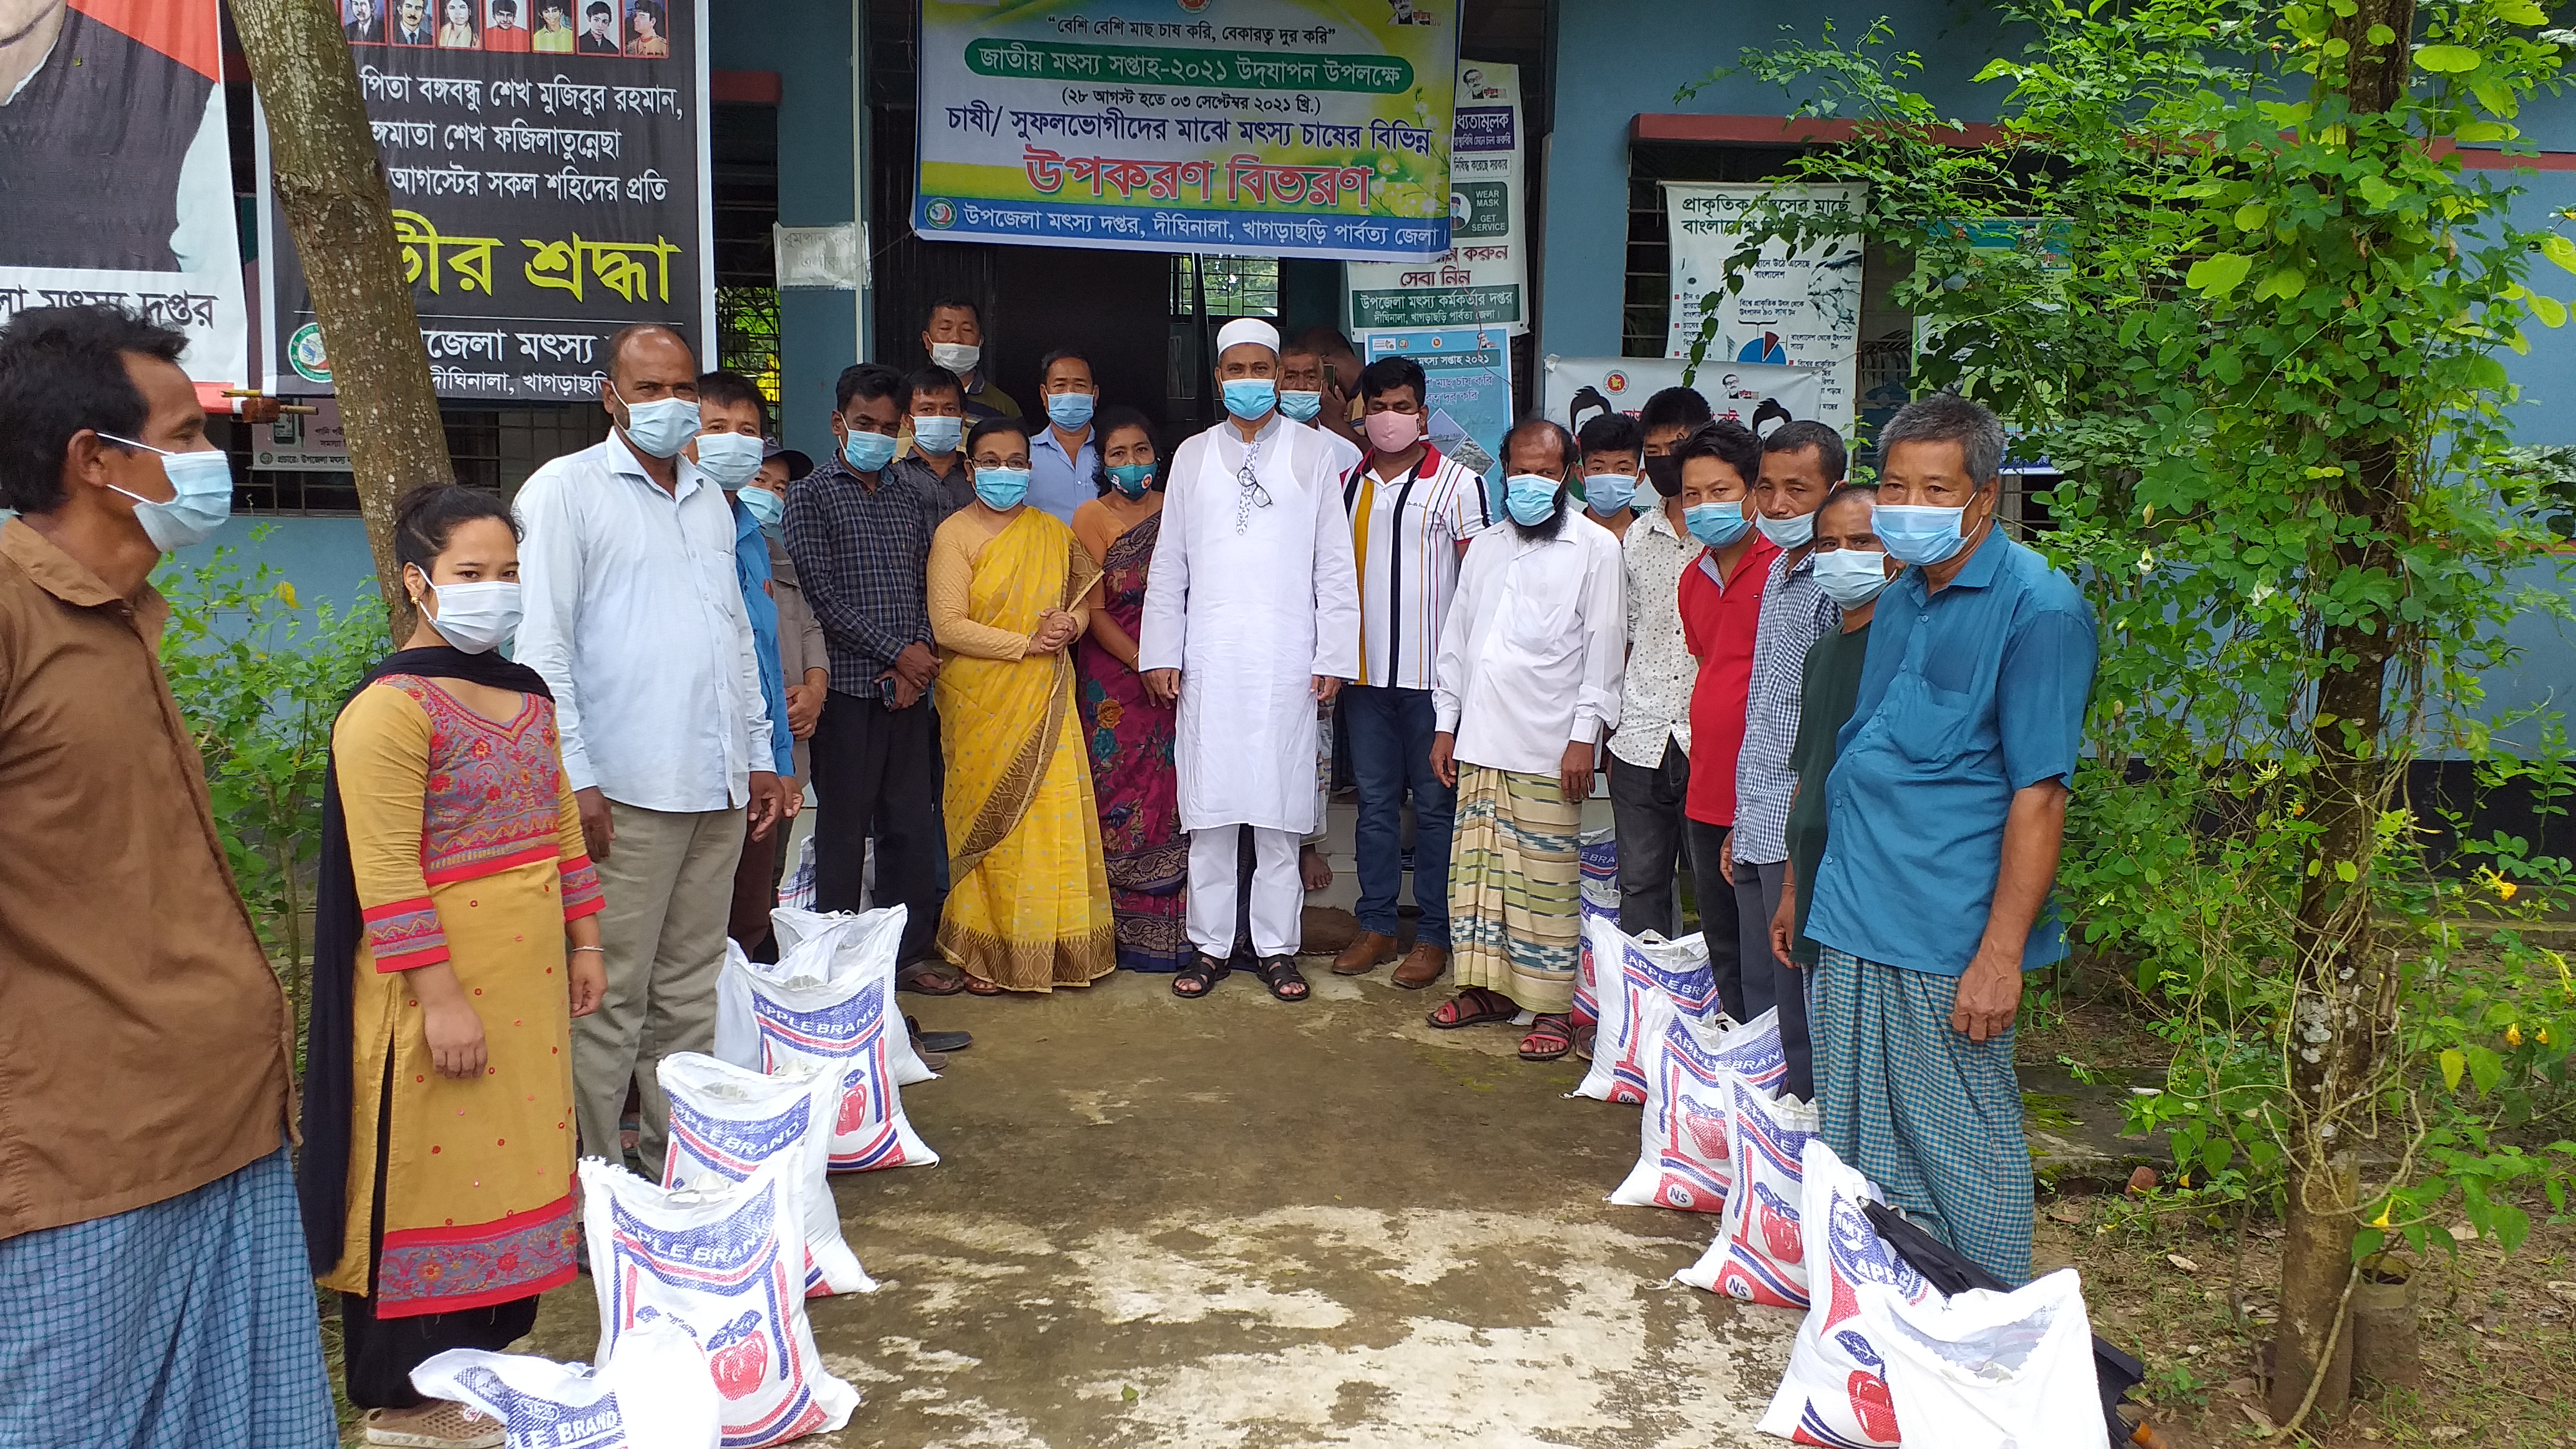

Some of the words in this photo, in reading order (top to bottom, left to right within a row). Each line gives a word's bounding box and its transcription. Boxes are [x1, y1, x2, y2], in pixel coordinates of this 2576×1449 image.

[1093, 16, 1125, 36] বেশি
[1129, 21, 1154, 38] মাছ
[1158, 22, 1181, 39] চাষ
[1186, 21, 1216, 42] করি,
[1222, 25, 1274, 46] বেকারত্ব
[978, 42, 1045, 72] জাতীয়
[1050, 52, 1103, 76] মৎস্য
[1322, 57, 1402, 87] উপলক্ষে
[359, 65, 412, 104] পিতা
[416, 76, 483, 114] বঙ্গবন্ধু
[490, 78, 532, 109] শেখ
[537, 74, 607, 118] মুজিবুর
[613, 85, 683, 121] রহমান,
[1092, 87, 1136, 105] আগস্ট
[1138, 92, 1166, 108] হতে
[1171, 96, 1191, 107] ০৩
[1196, 91, 1248, 110] সেপ্টেম্বর
[1254, 98, 1290, 113] ২০২১
[1009, 106, 1169, 142] সুফলভোগীদের
[1175, 116, 1231, 144] মাঝে
[1237, 121, 1296, 148] মৎস্য
[1300, 120, 1364, 150] চাষের
[1368, 118, 1433, 157] বিভিন্ন
[1455, 114, 1509, 133] ধ্যতামূলক
[368, 119, 437, 150] ঙ্গমাতা
[444, 121, 486, 153] শেখ
[492, 117, 623, 162] ফজিলাতুন্নেছা
[1023, 143, 1216, 202] উপকরণ
[1224, 152, 1373, 208] বিতরণ
[1490, 159, 1508, 170] সরকার
[388, 161, 481, 197] আগস্টের
[488, 172, 539, 200] সকল
[545, 165, 620, 205] শহিদের
[627, 168, 670, 204] প্রতি
[1475, 190, 1500, 198] WEAR
[1476, 199, 1500, 207] MASK
[963, 203, 1043, 230] উপজেলা
[1047, 213, 1095, 233] মৎস্য
[1099, 215, 1146, 238] দপ্তর,
[1151, 212, 1235, 242] দীঘিনালা,
[1242, 218, 1328, 246] খাগড়াছড়ি
[1334, 220, 1390, 245] পার্বত্য
[1471, 223, 1506, 232] SERVICE
[1461, 245, 1509, 262] করুন
[520, 230, 683, 305] শ্রদ্ধা
[1399, 271, 1437, 288] সেবা
[1440, 265, 1471, 286] নিন
[1359, 293, 1406, 310] উপজেলা
[1408, 295, 1436, 309] মৎস্য
[1438, 288, 1486, 308] কর্মকর্তার
[1488, 291, 1514, 305] দপ্তর
[1373, 311, 1408, 325] দীঘিনালা,
[1410, 310, 1448, 324] খাগড়াছড়ি
[1449, 310, 1473, 322] পার্বত্য
[514, 333, 599, 364] মৎস্য
[1417, 356, 1438, 366] মৎস্য
[1441, 355, 1463, 366] সপ্তাহ
[1465, 354, 1490, 364] ২০২১
[1435, 376, 1454, 389] মাছ
[1455, 376, 1471, 387] চাষ
[1474, 373, 1493, 385] করি
[1459, 388, 1478, 401] করি
[1589, 854, 1616, 864] BRA
[1629, 955, 1680, 991] APPLE
[758, 1001, 812, 1032] APPLE
[816, 1004, 878, 1035] BRAND
[1731, 1051, 1780, 1070] BRAN
[724, 1123, 799, 1156] BRAND
[1669, 1188, 1688, 1203] NS
[1729, 1277, 1748, 1297] NS
[557, 1410, 618, 1443] BRAND
